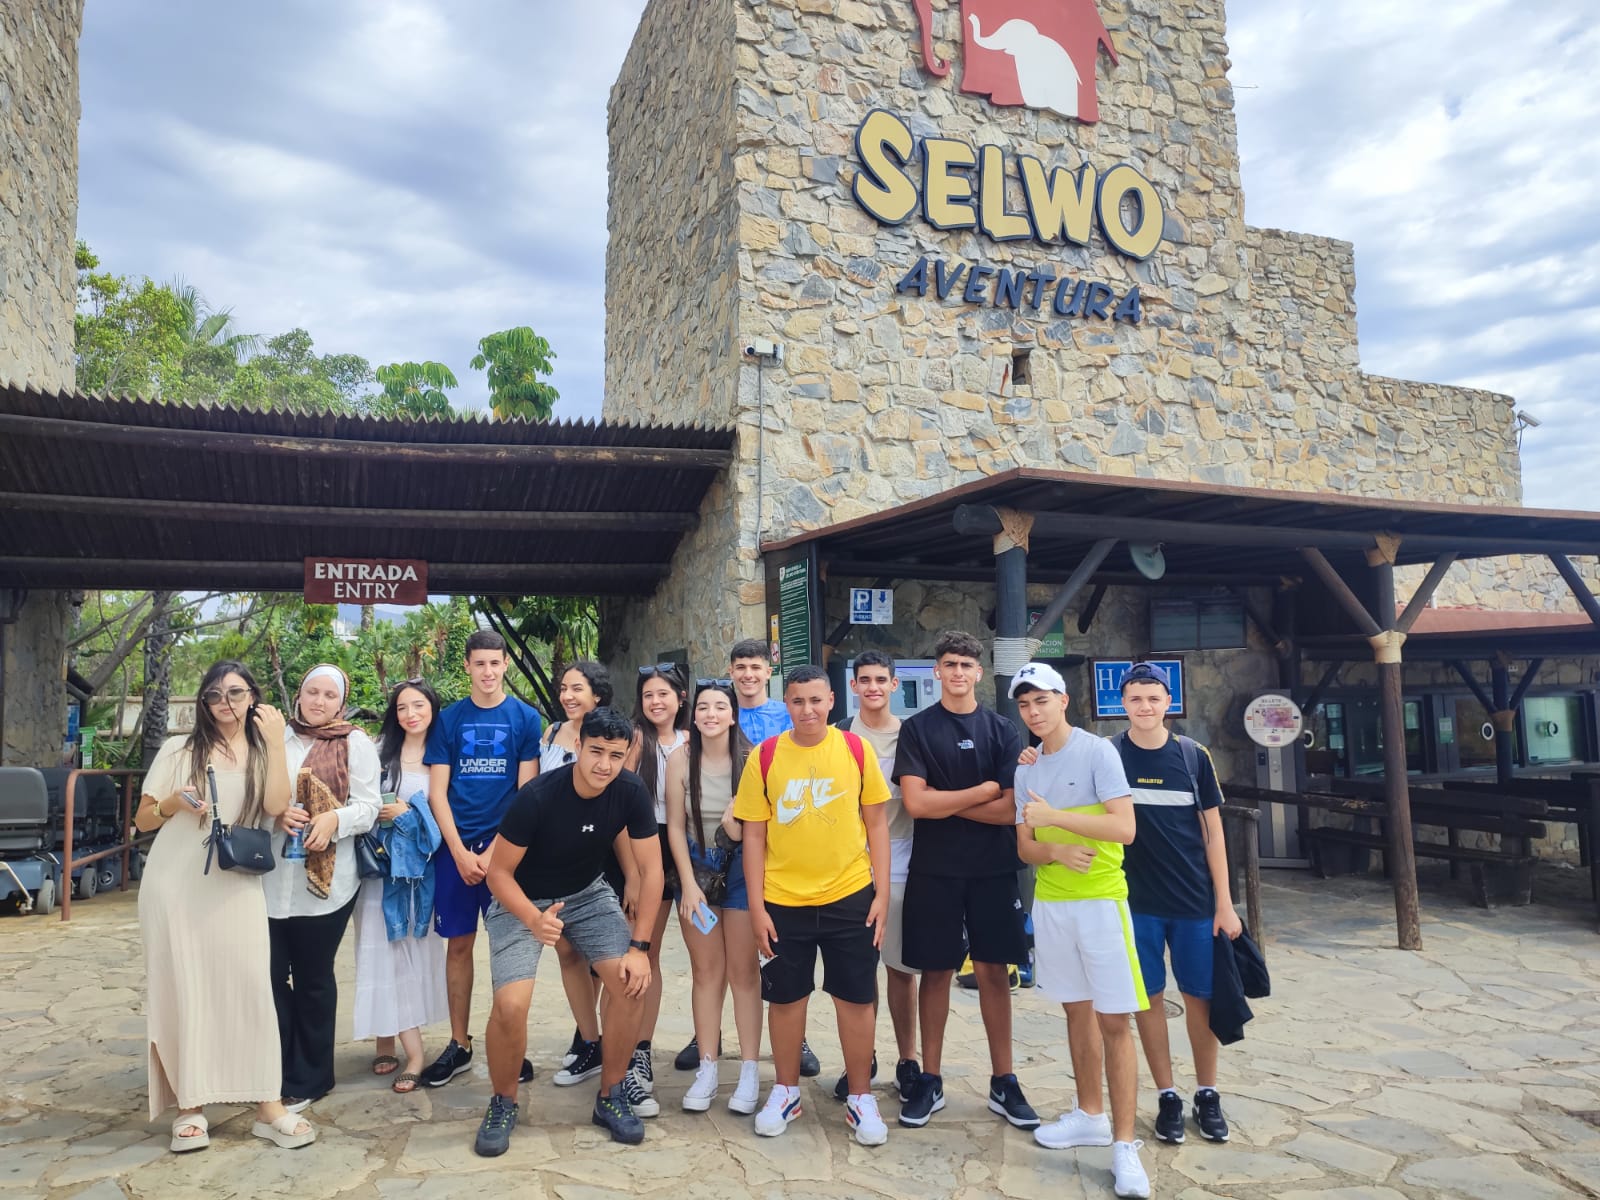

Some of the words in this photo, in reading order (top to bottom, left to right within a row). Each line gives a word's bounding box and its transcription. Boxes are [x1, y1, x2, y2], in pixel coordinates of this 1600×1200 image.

[853, 108, 1165, 261] SELWO
[896, 256, 1142, 323] AVENTURA
[314, 562, 419, 581] ENTRADA
[334, 581, 400, 599] ENTRY
[459, 758, 507, 767] UNDER
[460, 766, 506, 774] ARMOUR
